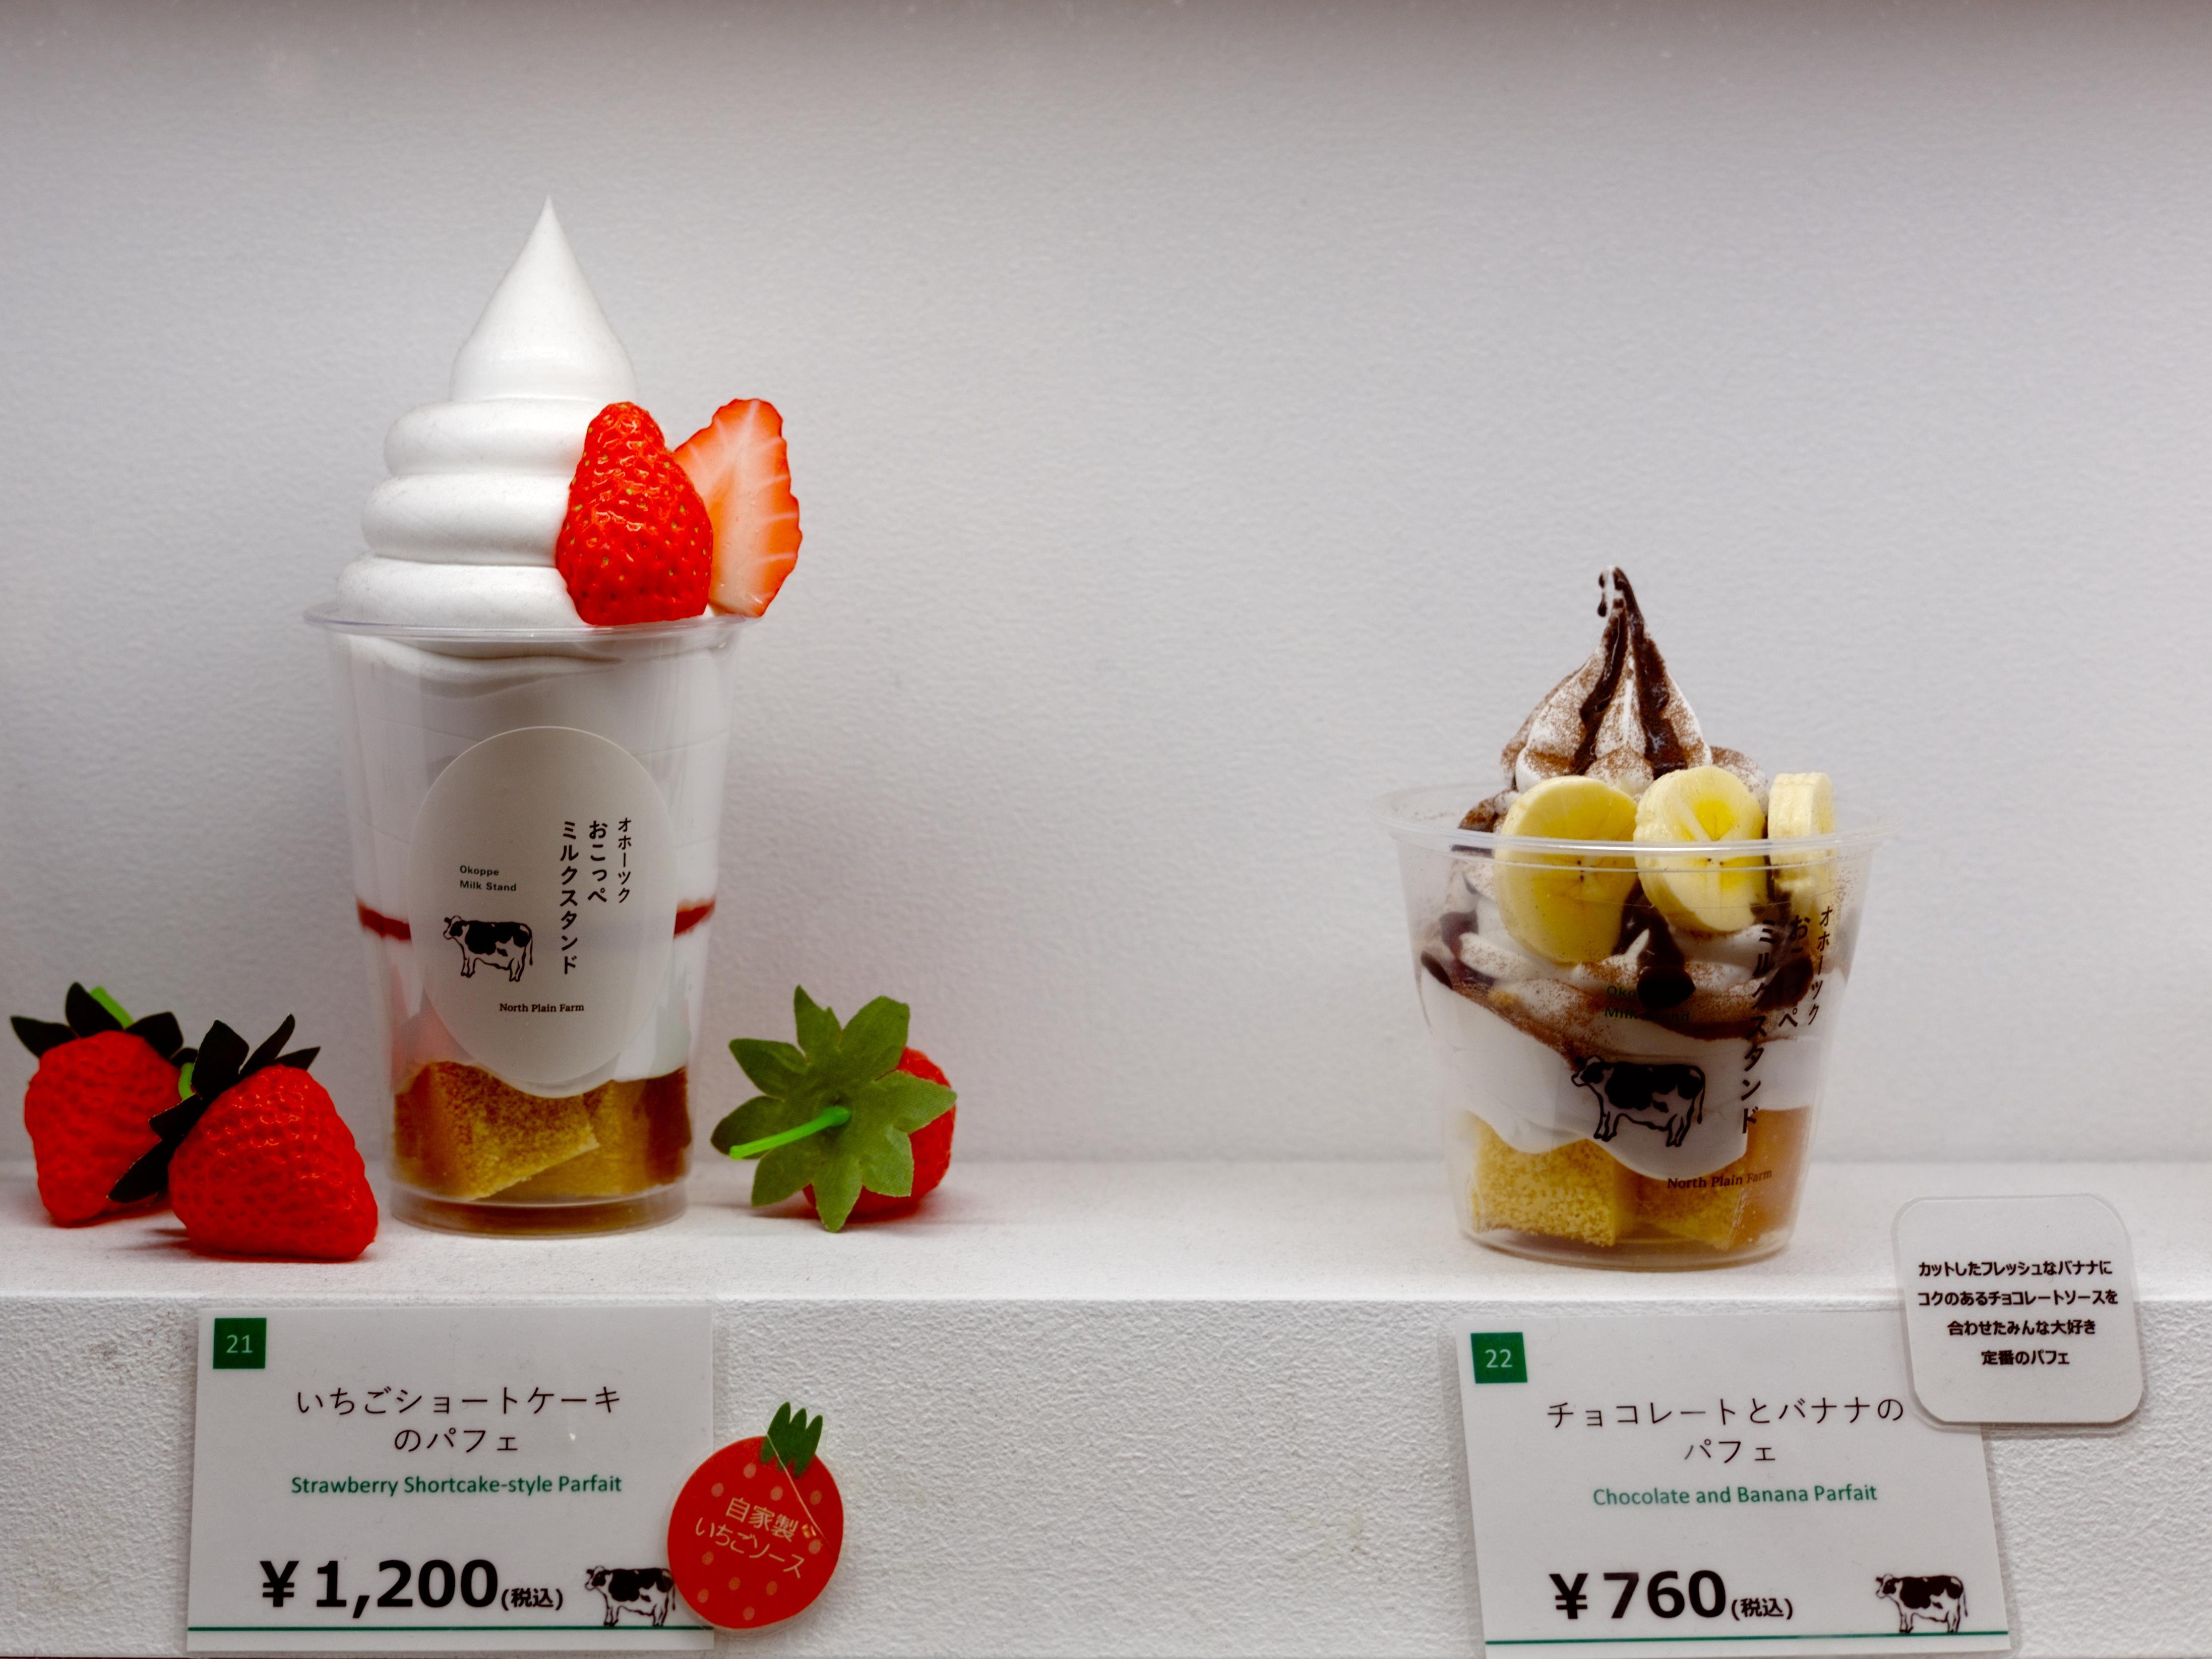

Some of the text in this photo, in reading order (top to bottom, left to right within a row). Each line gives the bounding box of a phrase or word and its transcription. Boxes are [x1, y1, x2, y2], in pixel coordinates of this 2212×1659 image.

[459, 865, 500, 877] Okoppe
[587, 820, 608, 903] おこっぺ
[618, 817, 632, 903] オホーツク
[460, 880, 517, 892] Milk Stand
[559, 821, 579, 975] ミルクスタンド
[1808, 906, 1833, 1025] オホーツク
[499, 1003, 584, 1013] North Plain Farm
[1667, 1169, 1772, 1188] North Plain Farm
[1918, 1260, 2113, 1277] カットしたフレッシュなバナナに
[1918, 1289, 2119, 1307] コクのあるチョコレートソースを
[1947, 1319, 2096, 1336] 合わせたみんな大好き
[226, 1334, 253, 1353] 21
[1486, 1348, 1512, 1368] 22
[1981, 1349, 2070, 1366] 定番のパフェ
[297, 1386, 620, 1416] いちごショートケーキ
[1547, 1396, 1903, 1429] チョコレートとバナナの
[394, 1427, 518, 1453] のパフェ
[1685, 1439, 1775, 1463] パフェ
[291, 1474, 622, 1497] Strawberry Shortcake-style Parfait
[1593, 1484, 1877, 1506] Chocolate and Banana Parfait
[726, 1498, 799, 1543] 自家製
[696, 1517, 805, 1578] いちごソース
